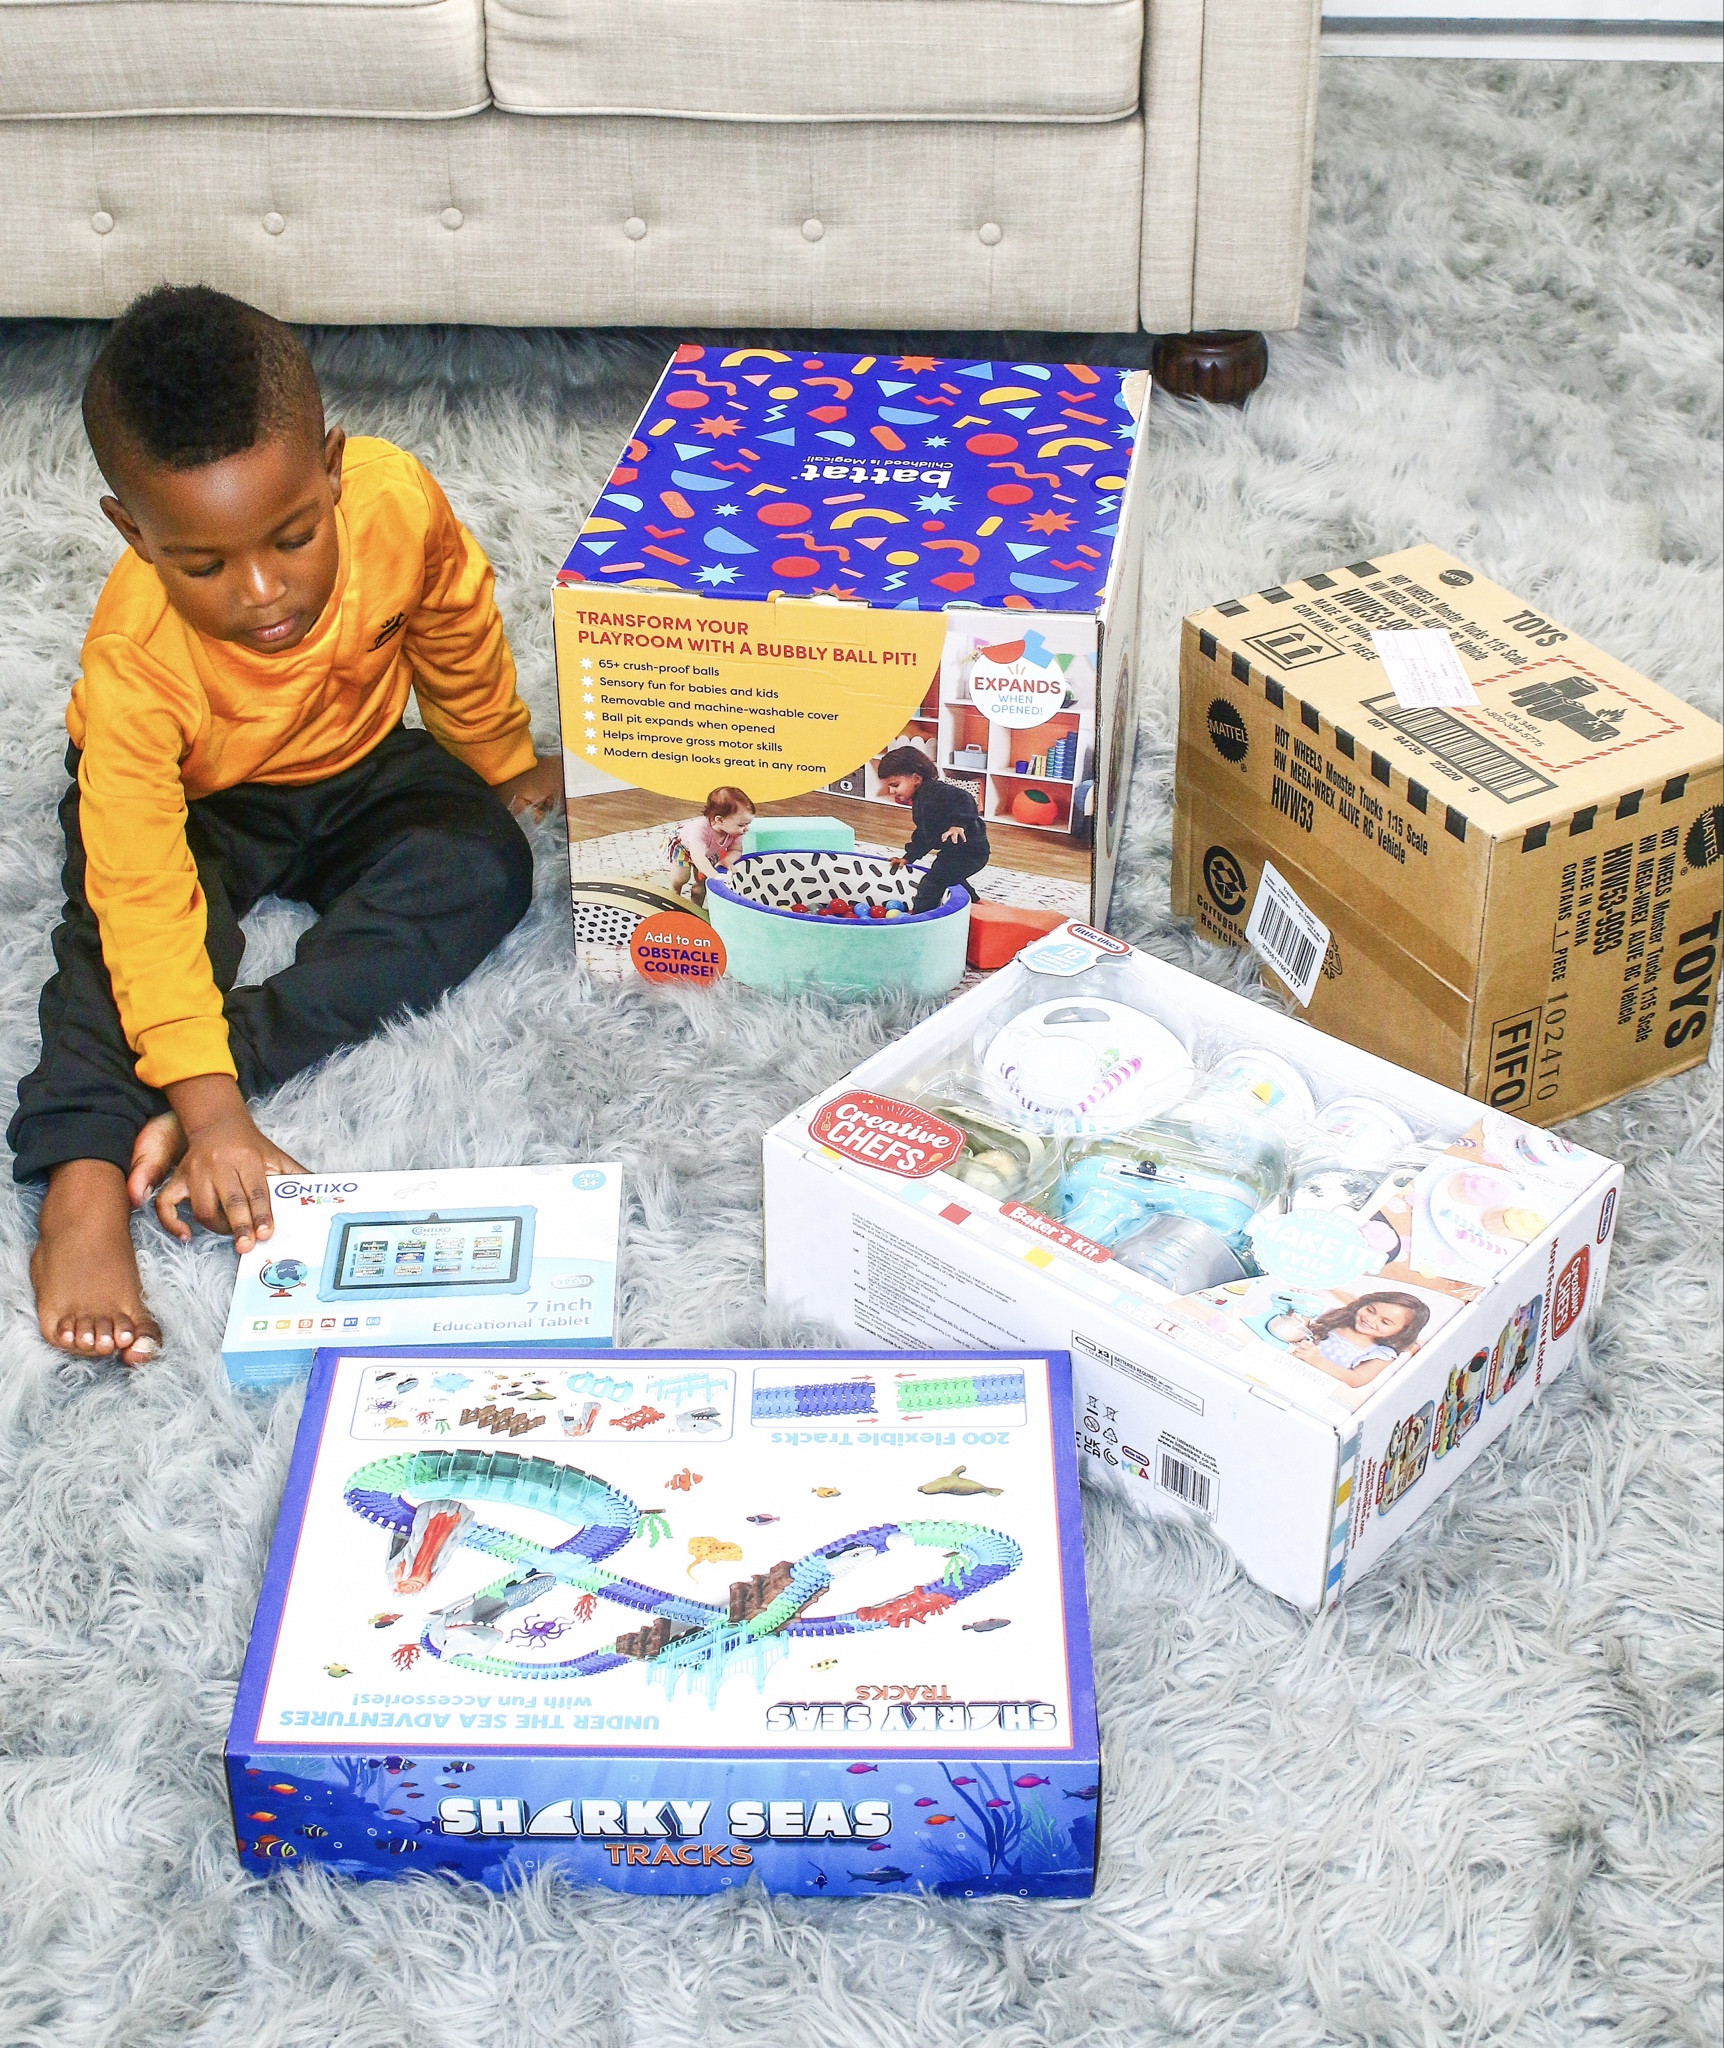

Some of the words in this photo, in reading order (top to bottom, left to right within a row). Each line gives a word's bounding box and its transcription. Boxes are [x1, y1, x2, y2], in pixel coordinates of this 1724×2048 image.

[801, 464, 952, 489] battat
[884, 460, 954, 469] Childhood
[576, 611, 692, 631] TRANSFORM
[696, 619, 749, 635] YOUR
[1311, 598, 1342, 616] MADE
[1335, 614, 1353, 624] IN
[1365, 580, 1390, 592] HW
[1379, 589, 1432, 620] MEGA-WREX
[1454, 640, 1488, 661] Vehicle
[1387, 574, 1413, 586] HOT
[1404, 584, 1440, 604] WHEELS
[1430, 602, 1465, 624] Monster
[1459, 621, 1490, 641] Trucks
[1484, 638, 1510, 652] 1:15
[1499, 649, 1529, 666] Scale
[1292, 604, 1338, 633] CONTAINS
[1347, 642, 1380, 661] PIECE
[1502, 609, 1570, 648] TOYS
[578, 630, 683, 650] PLAYROOM
[687, 638, 735, 654] WITH
[739, 642, 753, 656] A
[757, 643, 828, 661] BUBBLY
[833, 648, 878, 664] BALL
[882, 651, 917, 666] PIT!
[598, 659, 620, 669] 65+
[623, 660, 691, 674] crush-proof
[692, 666, 720, 677] balls
[599, 676, 645, 690] Sensory
[648, 680, 667, 691] fun
[669, 681, 685, 692] for
[688, 683, 727, 696] babies
[730, 686, 753, 697] and
[756, 687, 779, 699] kids
[974, 677, 1061, 695] EXPANDS
[601, 694, 666, 708] Removable
[668, 700, 691, 710] and
[694, 703, 804, 719] machine-washable
[807, 712, 839, 721] cover
[991, 704, 1043, 716] OPENED!
[998, 695, 1033, 704] WHEN
[602, 712, 623, 722] Ball
[626, 714, 642, 725] pit
[645, 718, 694, 727] expands
[697, 720, 728, 730] when
[731, 725, 775, 734] opened
[1208, 719, 1248, 743] MATTEL
[1482, 707, 1545, 748] 1-800-334-5775
[1504, 711, 1519, 722] UN
[1518, 720, 1543, 735] 3481
[603, 730, 634, 741] Helps
[637, 732, 683, 744] improve
[686, 738, 716, 747] gross
[718, 740, 754, 750] motor
[756, 742, 783, 752] skills
[1366, 718, 1389, 731] 001
[1392, 735, 1427, 756] 94735
[1430, 760, 1463, 782] 22220
[604, 747, 648, 758] Modern
[651, 750, 688, 763] design
[691, 754, 721, 765] looks
[724, 758, 755, 768] great
[758, 759, 769, 768] in
[772, 762, 793, 772] any
[796, 764, 826, 773] room
[1275, 724, 1290, 750] HOT
[1294, 737, 1323, 774] WHEELS
[1326, 761, 1355, 799] Monster
[1360, 786, 1383, 822] Trucks
[1388, 810, 1404, 837] 1:15
[1406, 823, 1428, 856] Scale
[1271, 774, 1314, 833] HWW53
[1274, 748, 1287, 773] HW
[1290, 759, 1336, 809] MEGA-WREX
[1339, 797, 1360, 829] ALIVE
[1363, 815, 1374, 839] RC
[1378, 826, 1406, 864] Vehicle
[1639, 833, 1657, 854] HW
[1661, 825, 1679, 849] HOT
[1702, 809, 1718, 865] MATTEL
[1580, 856, 1597, 891] MADE
[1655, 852, 1676, 897] WHEELS
[1558, 863, 1577, 921] CONTAINS
[1578, 893, 1593, 907] IN
[1593, 842, 1633, 955] HWW53-9993
[1631, 857, 1655, 927] MEGA-WREX
[1556, 930, 1569, 938] 1
[1574, 910, 1591, 947] CHINA
[1649, 899, 1670, 944] Monster
[645, 932, 672, 944] Add
[676, 934, 690, 945] to
[693, 939, 711, 947] an
[1074, 926, 1098, 941] little
[1097, 936, 1121, 951] tikes
[1626, 930, 1646, 962] ALIVE
[637, 946, 719, 964] OBSTACLE
[1551, 947, 1568, 982] PIECE
[1643, 946, 1664, 984] Trucks
[644, 961, 714, 977] COURSE!
[1624, 963, 1642, 981] RC
[1664, 910, 1722, 1048] TOYS
[1618, 983, 1639, 1025] Vehicle
[1640, 987, 1658, 1011] 1:15
[1636, 1012, 1655, 1043] Scale
[1490, 1020, 1532, 1107] FIFO
[836, 1103, 953, 1149] Creative
[827, 1120, 925, 1171] CHEFS
[274, 1181, 358, 1199] CONTIXO
[579, 1178, 598, 1187] 3+
[1009, 1206, 1073, 1244] Baker's
[1071, 1238, 1100, 1258] Kit
[1245, 1214, 1343, 1259] MAKE
[1278, 1249, 1331, 1275] mix
[1549, 1237, 1559, 1273] More
[1545, 1272, 1555, 1311] From
[1571, 1256, 1582, 1317] Creative
[526, 1301, 539, 1314] 7
[546, 1298, 593, 1313] inch
[1555, 1272, 1574, 1331] CHEFS
[432, 1318, 532, 1332] Educational
[538, 1315, 591, 1328] Tablet
[1097, 1348, 1110, 1359] x3
[771, 1431, 853, 1446] Tracks
[857, 1431, 956, 1446] Flexible
[963, 1431, 1010, 1446] 200
[351, 1692, 492, 1708] Accessories!
[498, 1694, 537, 1708] Fun
[544, 1695, 592, 1710] with
[855, 1684, 952, 1701] TRACKS
[279, 1709, 452, 1728] ADVENTURES
[460, 1712, 507, 1729] SEA
[515, 1713, 565, 1730] THE
[573, 1714, 660, 1730] UNDER
[766, 1702, 872, 1732] SEAS
[728, 1797, 894, 1840] SEAS
[604, 1843, 755, 1867] TRACKS
